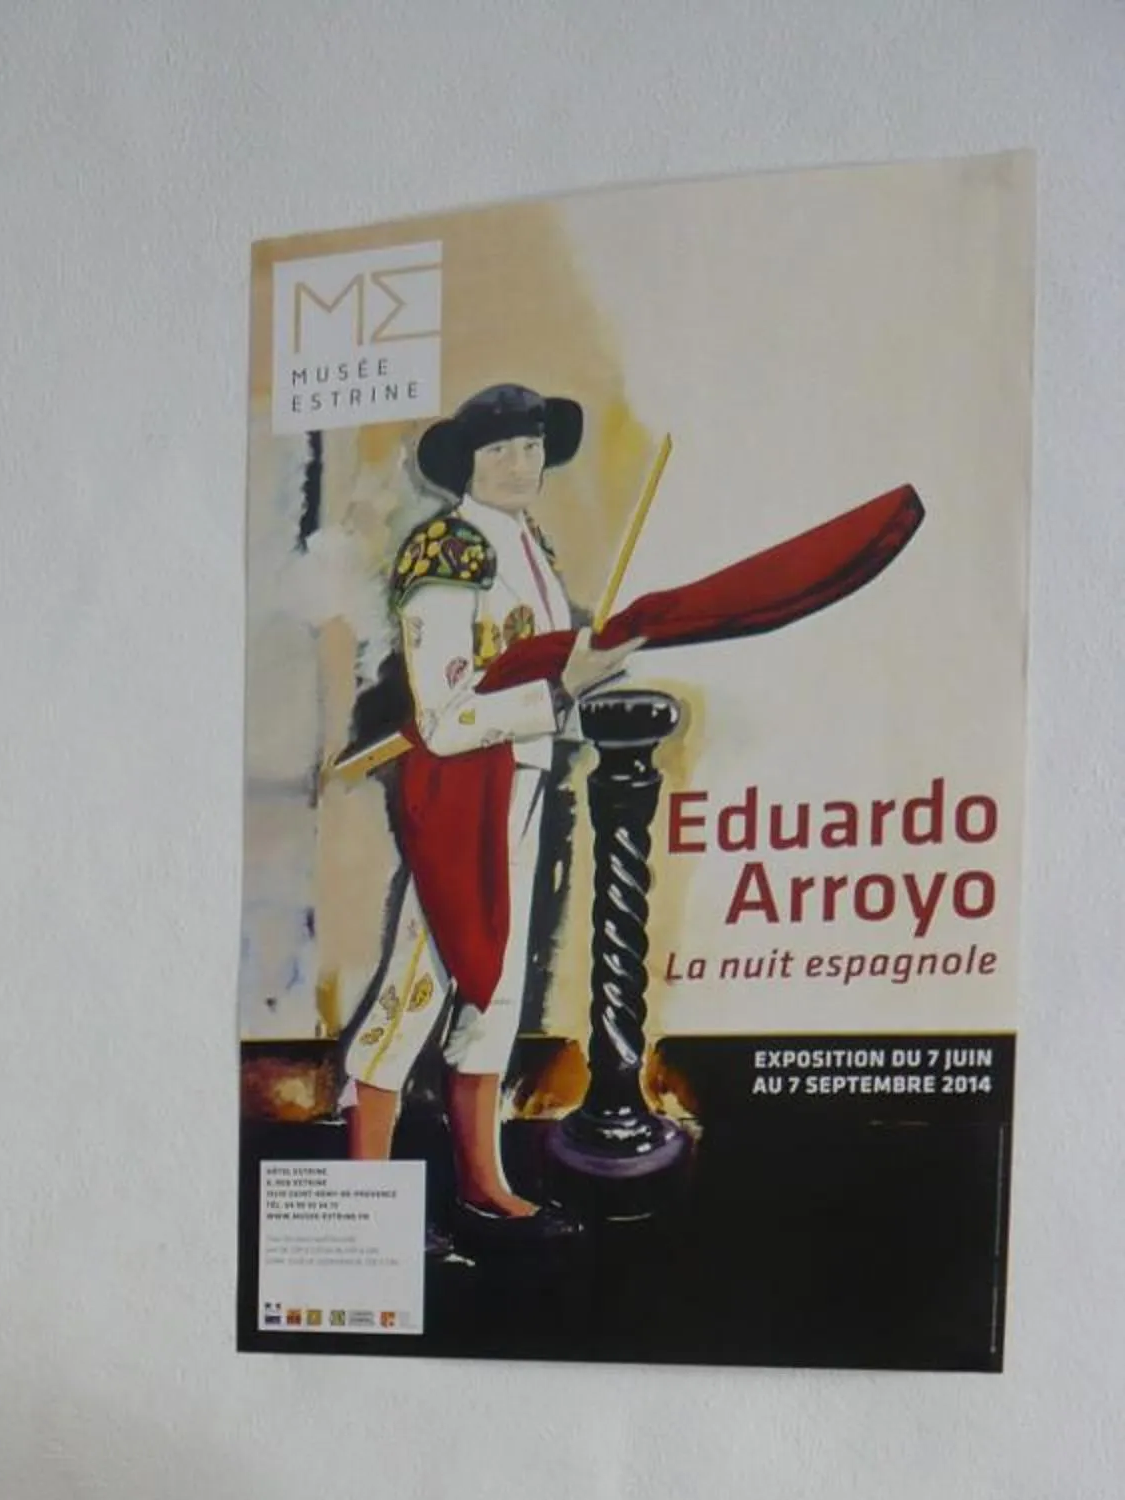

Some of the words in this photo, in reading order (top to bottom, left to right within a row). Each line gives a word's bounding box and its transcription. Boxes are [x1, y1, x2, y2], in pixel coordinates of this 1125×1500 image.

[291, 356, 389, 387] MUSÉE
[291, 381, 419, 413] ESTRINE
[668, 777, 998, 855] Eduardo
[725, 861, 996, 938] Arroyo
[664, 951, 707, 982] La
[719, 948, 795, 980] nuit
[805, 944, 998, 986] espagnole
[754, 1049, 885, 1068] EXPOSITION
[891, 1049, 921, 1068] DU
[927, 1050, 939, 1067] 7
[944, 1048, 993, 1070] JUIN
[752, 1076, 782, 1094] AU
[788, 1076, 800, 1094] 7
[805, 1075, 935, 1094] SEPTEMBRE
[941, 1075, 993, 1094] 2014
